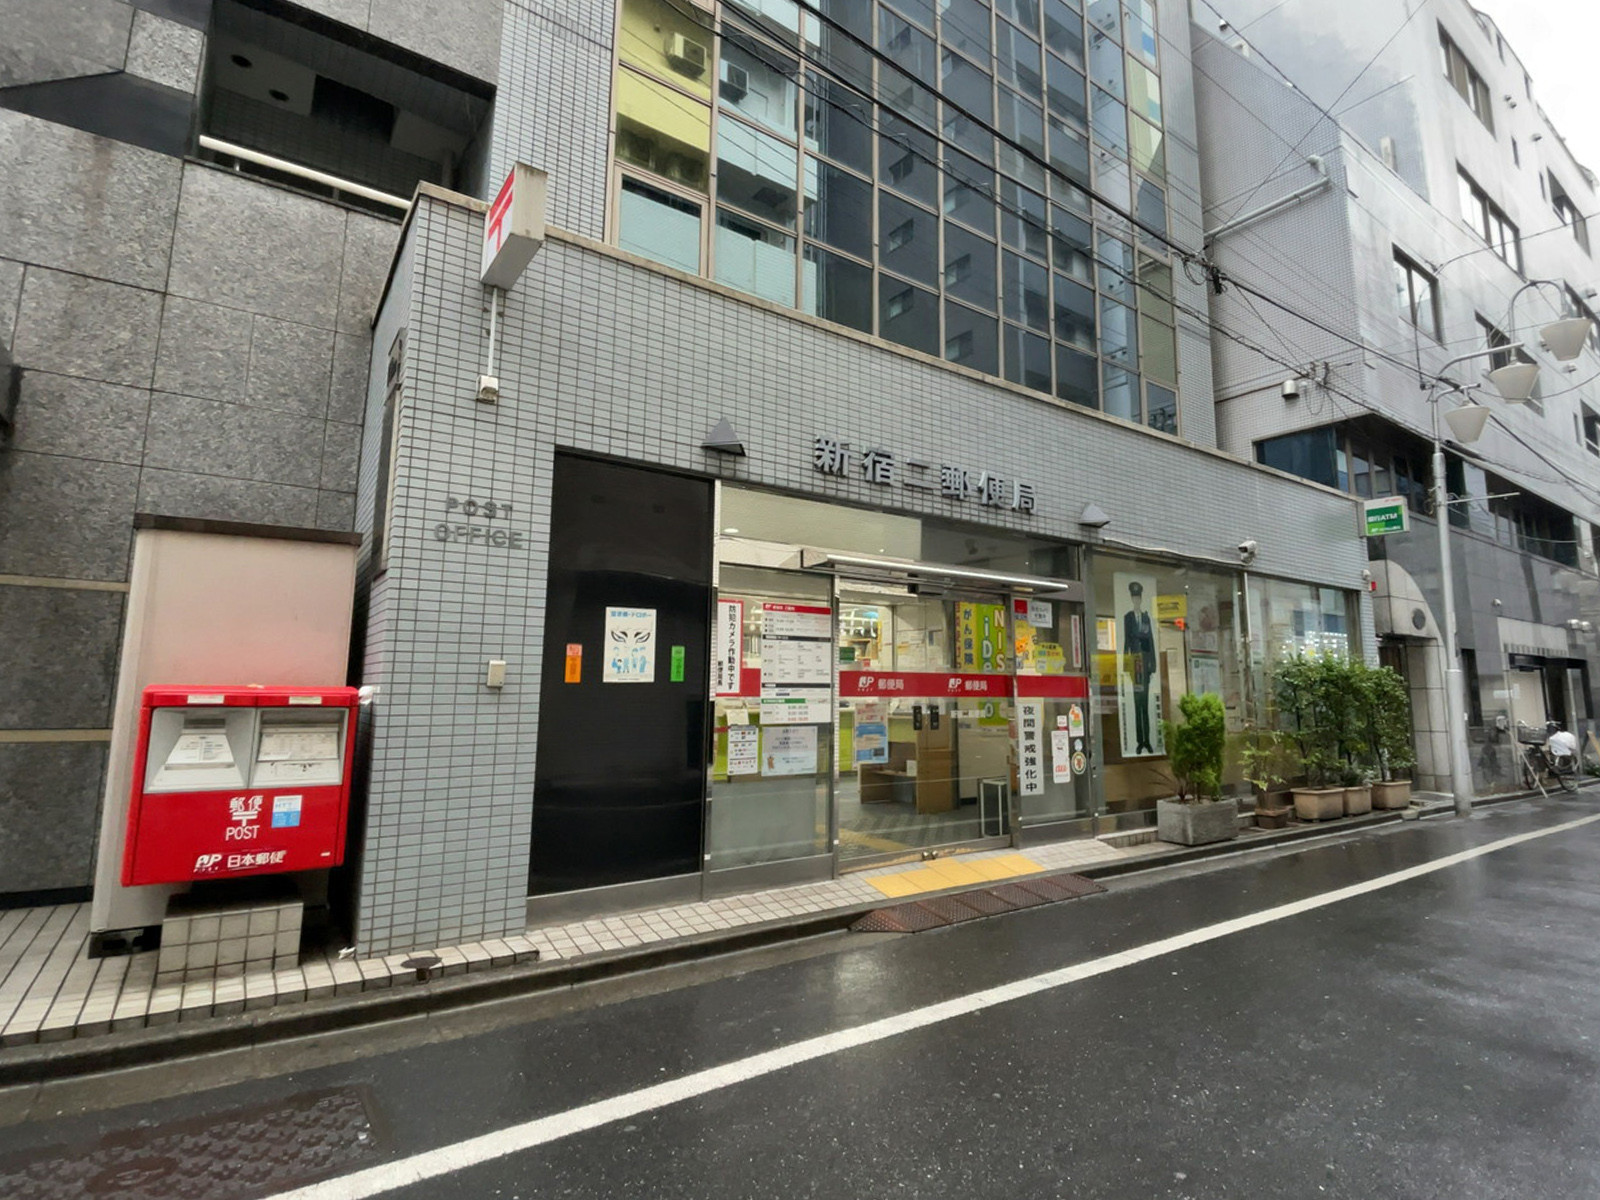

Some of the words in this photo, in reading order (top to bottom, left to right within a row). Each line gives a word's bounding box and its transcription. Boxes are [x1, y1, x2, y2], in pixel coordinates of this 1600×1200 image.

[815, 434, 1037, 515] 新宿二郵便局
[446, 497, 513, 520] POST
[434, 523, 523, 549] OFFICE
[994, 608, 1005, 673] NIS
[878, 678, 905, 691] 郵便局
[964, 680, 988, 691] 郵便局
[229, 795, 264, 813] 郵便
[225, 825, 261, 841] POST
[227, 850, 287, 868] 日本郵便
